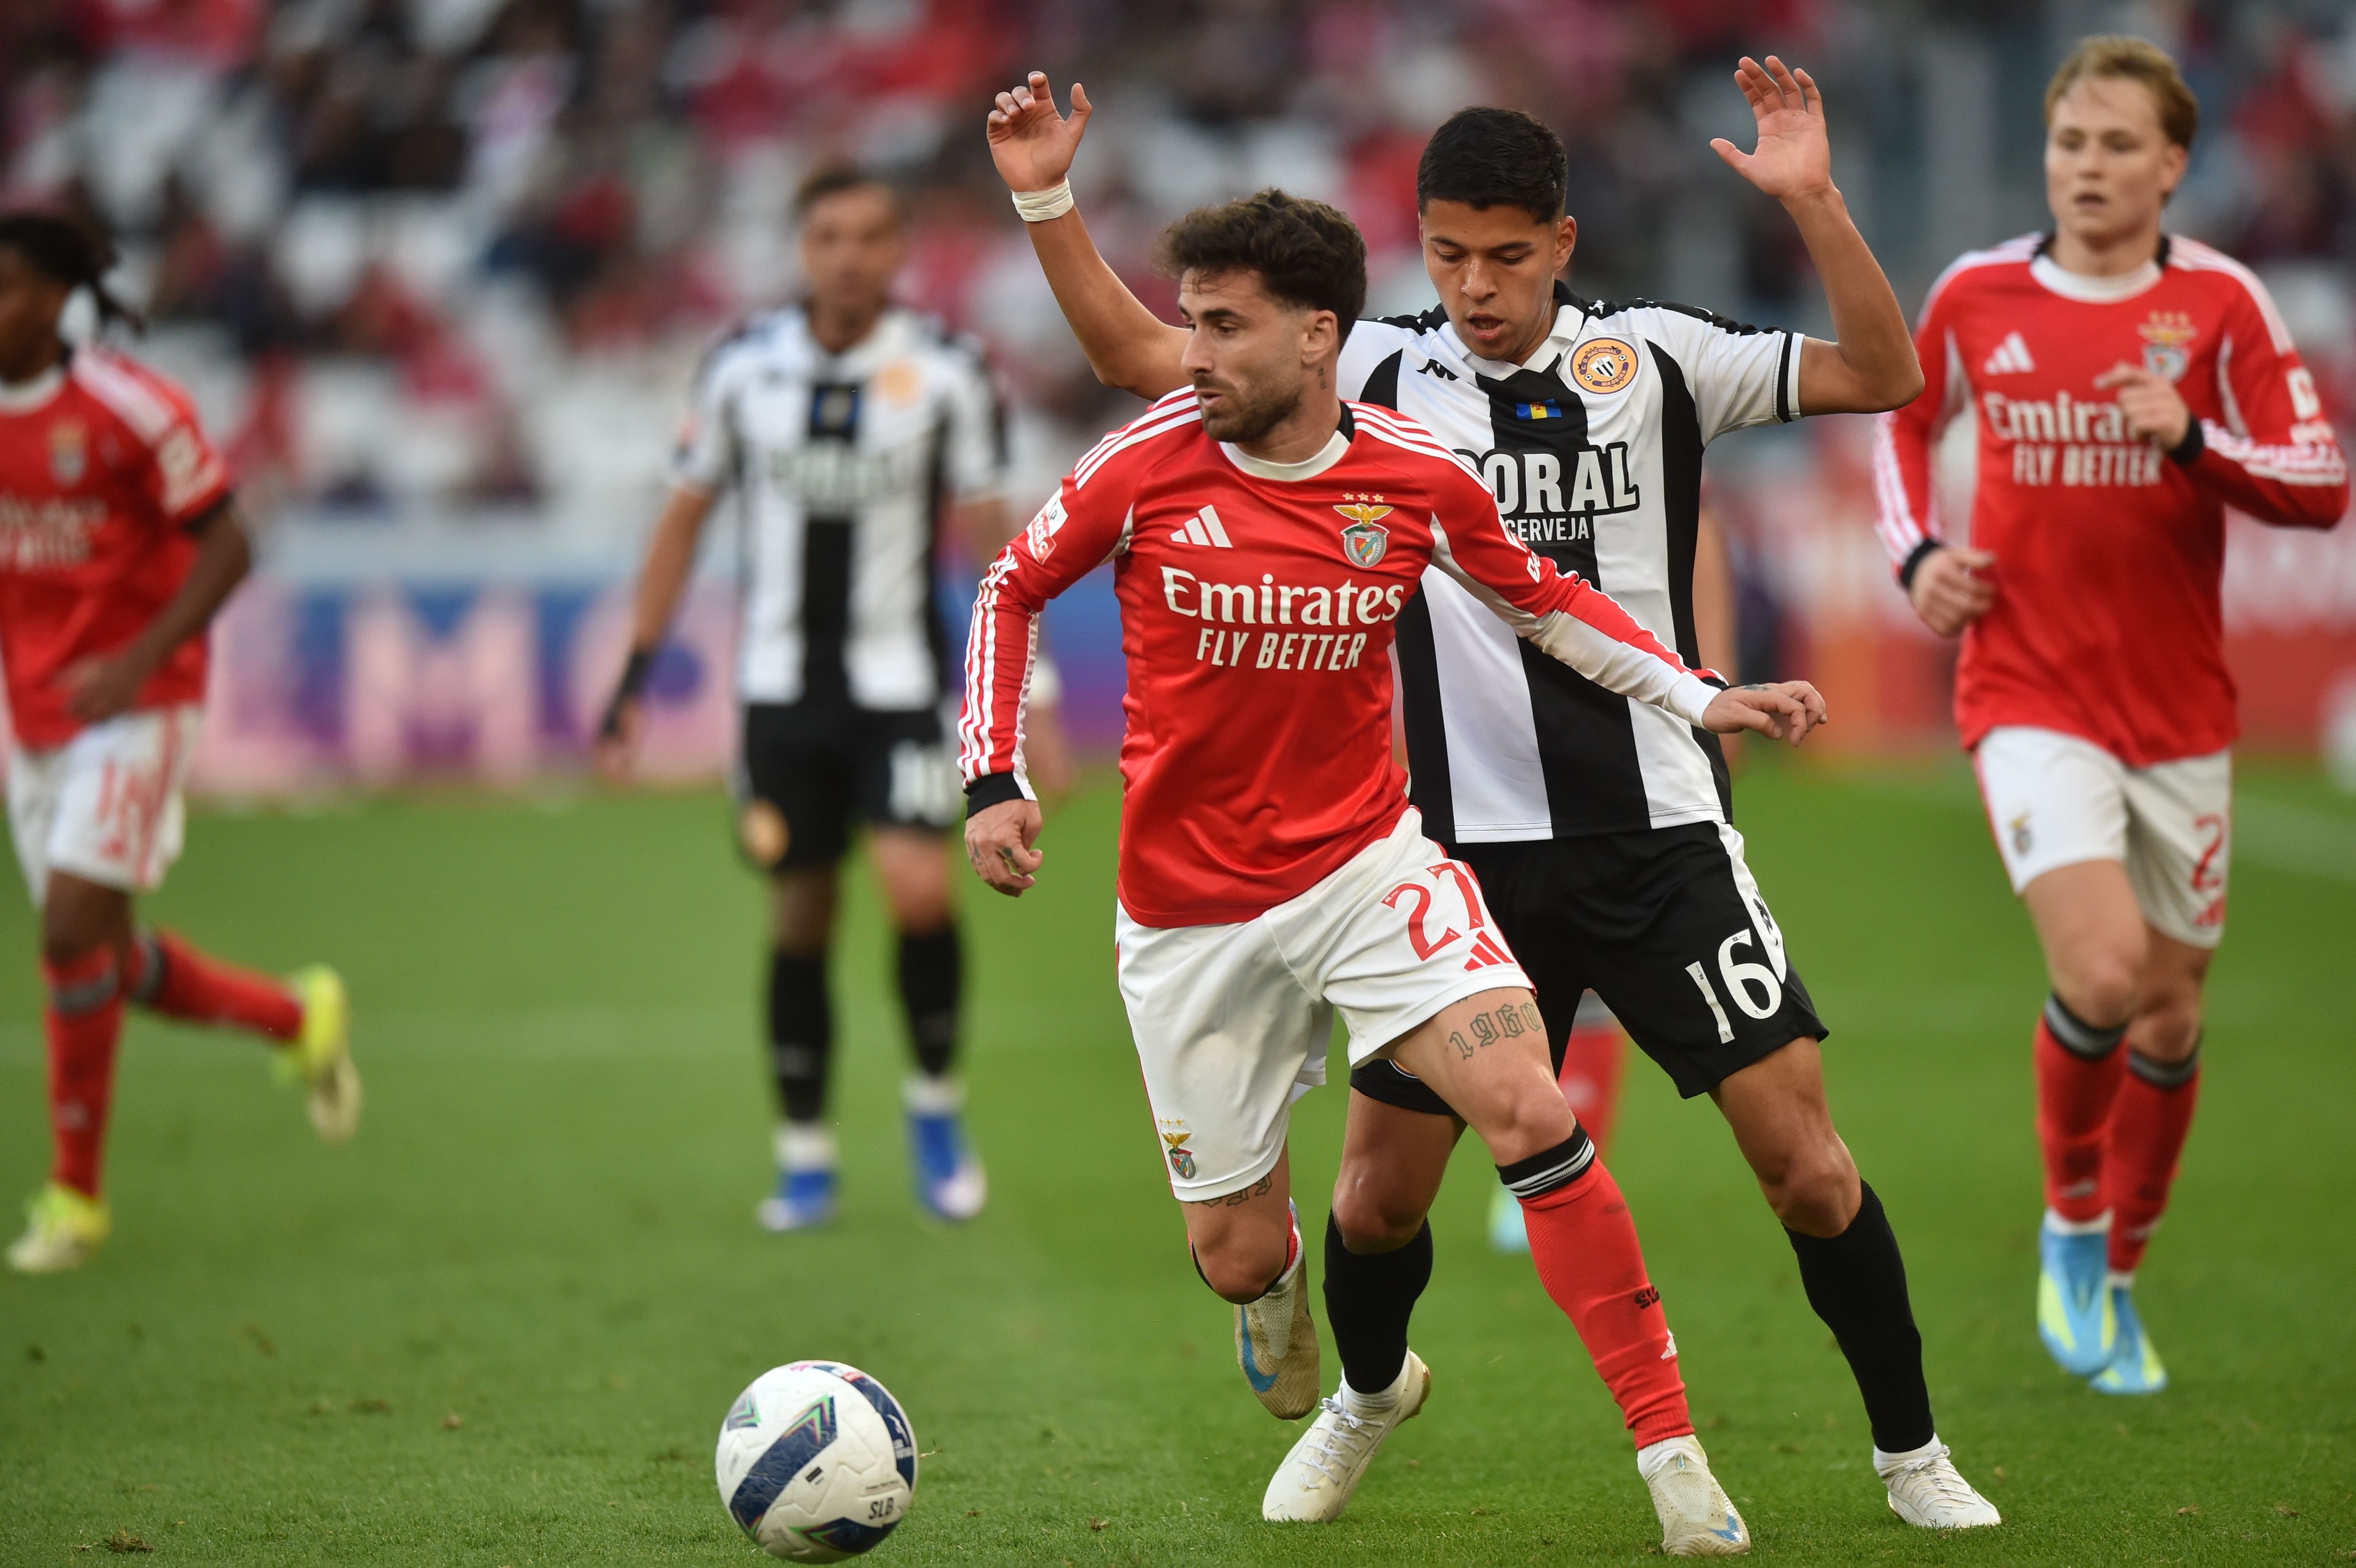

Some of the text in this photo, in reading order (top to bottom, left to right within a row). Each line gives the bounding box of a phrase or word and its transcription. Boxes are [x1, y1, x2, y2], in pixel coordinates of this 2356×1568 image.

[1586, 348, 1617, 358] NACIONAL
[1601, 370, 1626, 386] MADEIRA
[1983, 390, 2138, 441] Emira
[1455, 446, 1639, 515] ORAL
[2012, 442, 2163, 487] FLY BETTER
[1159, 566, 1405, 626] Emirates
[1196, 628, 1367, 671] FLY BETTER
[1381, 861, 1484, 962] 27
[1684, 928, 1782, 1045] 16
[868, 1497, 894, 1520] SLB
